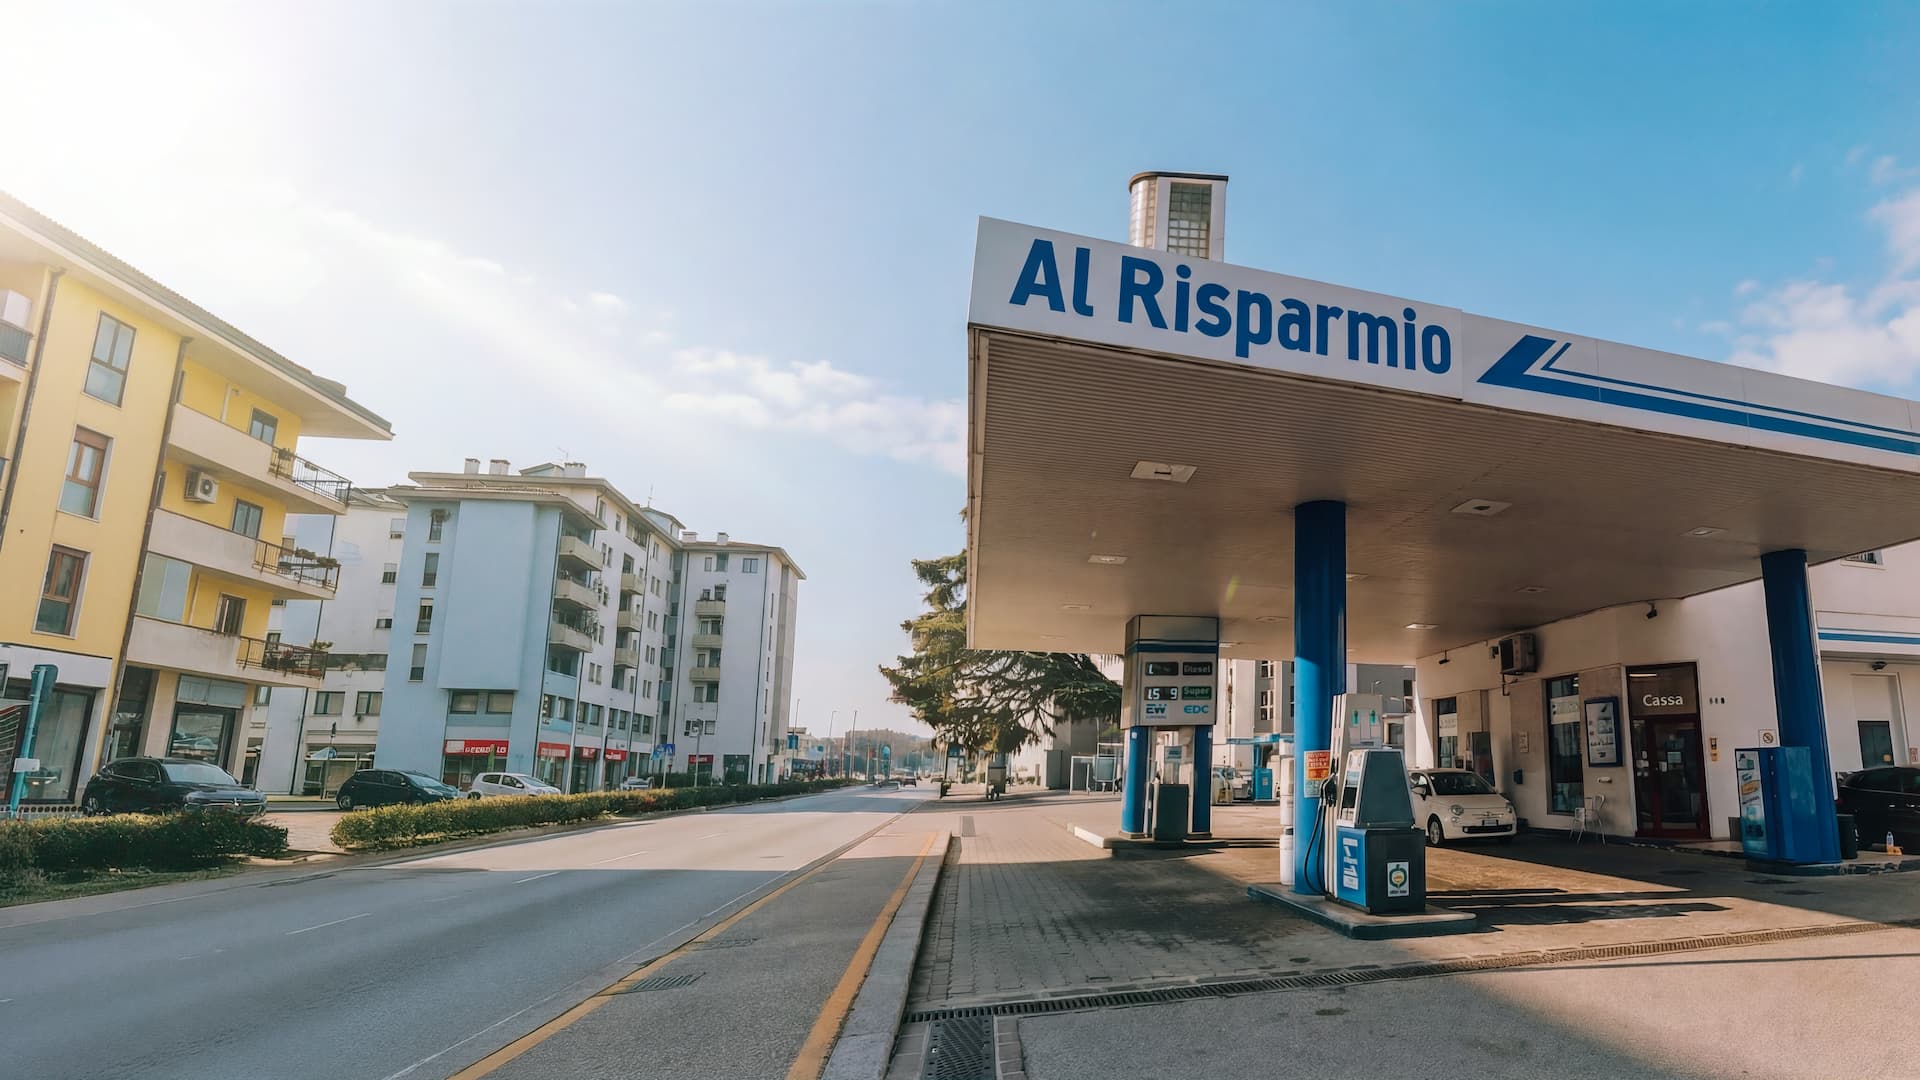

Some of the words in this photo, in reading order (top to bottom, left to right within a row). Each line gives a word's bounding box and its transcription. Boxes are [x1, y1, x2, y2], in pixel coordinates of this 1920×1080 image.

[1009, 238, 1093, 317] Al
[1118, 255, 1451, 374] Risparmio
[1184, 687, 1210, 696] Super
[1642, 694, 1684, 707] Cassa
